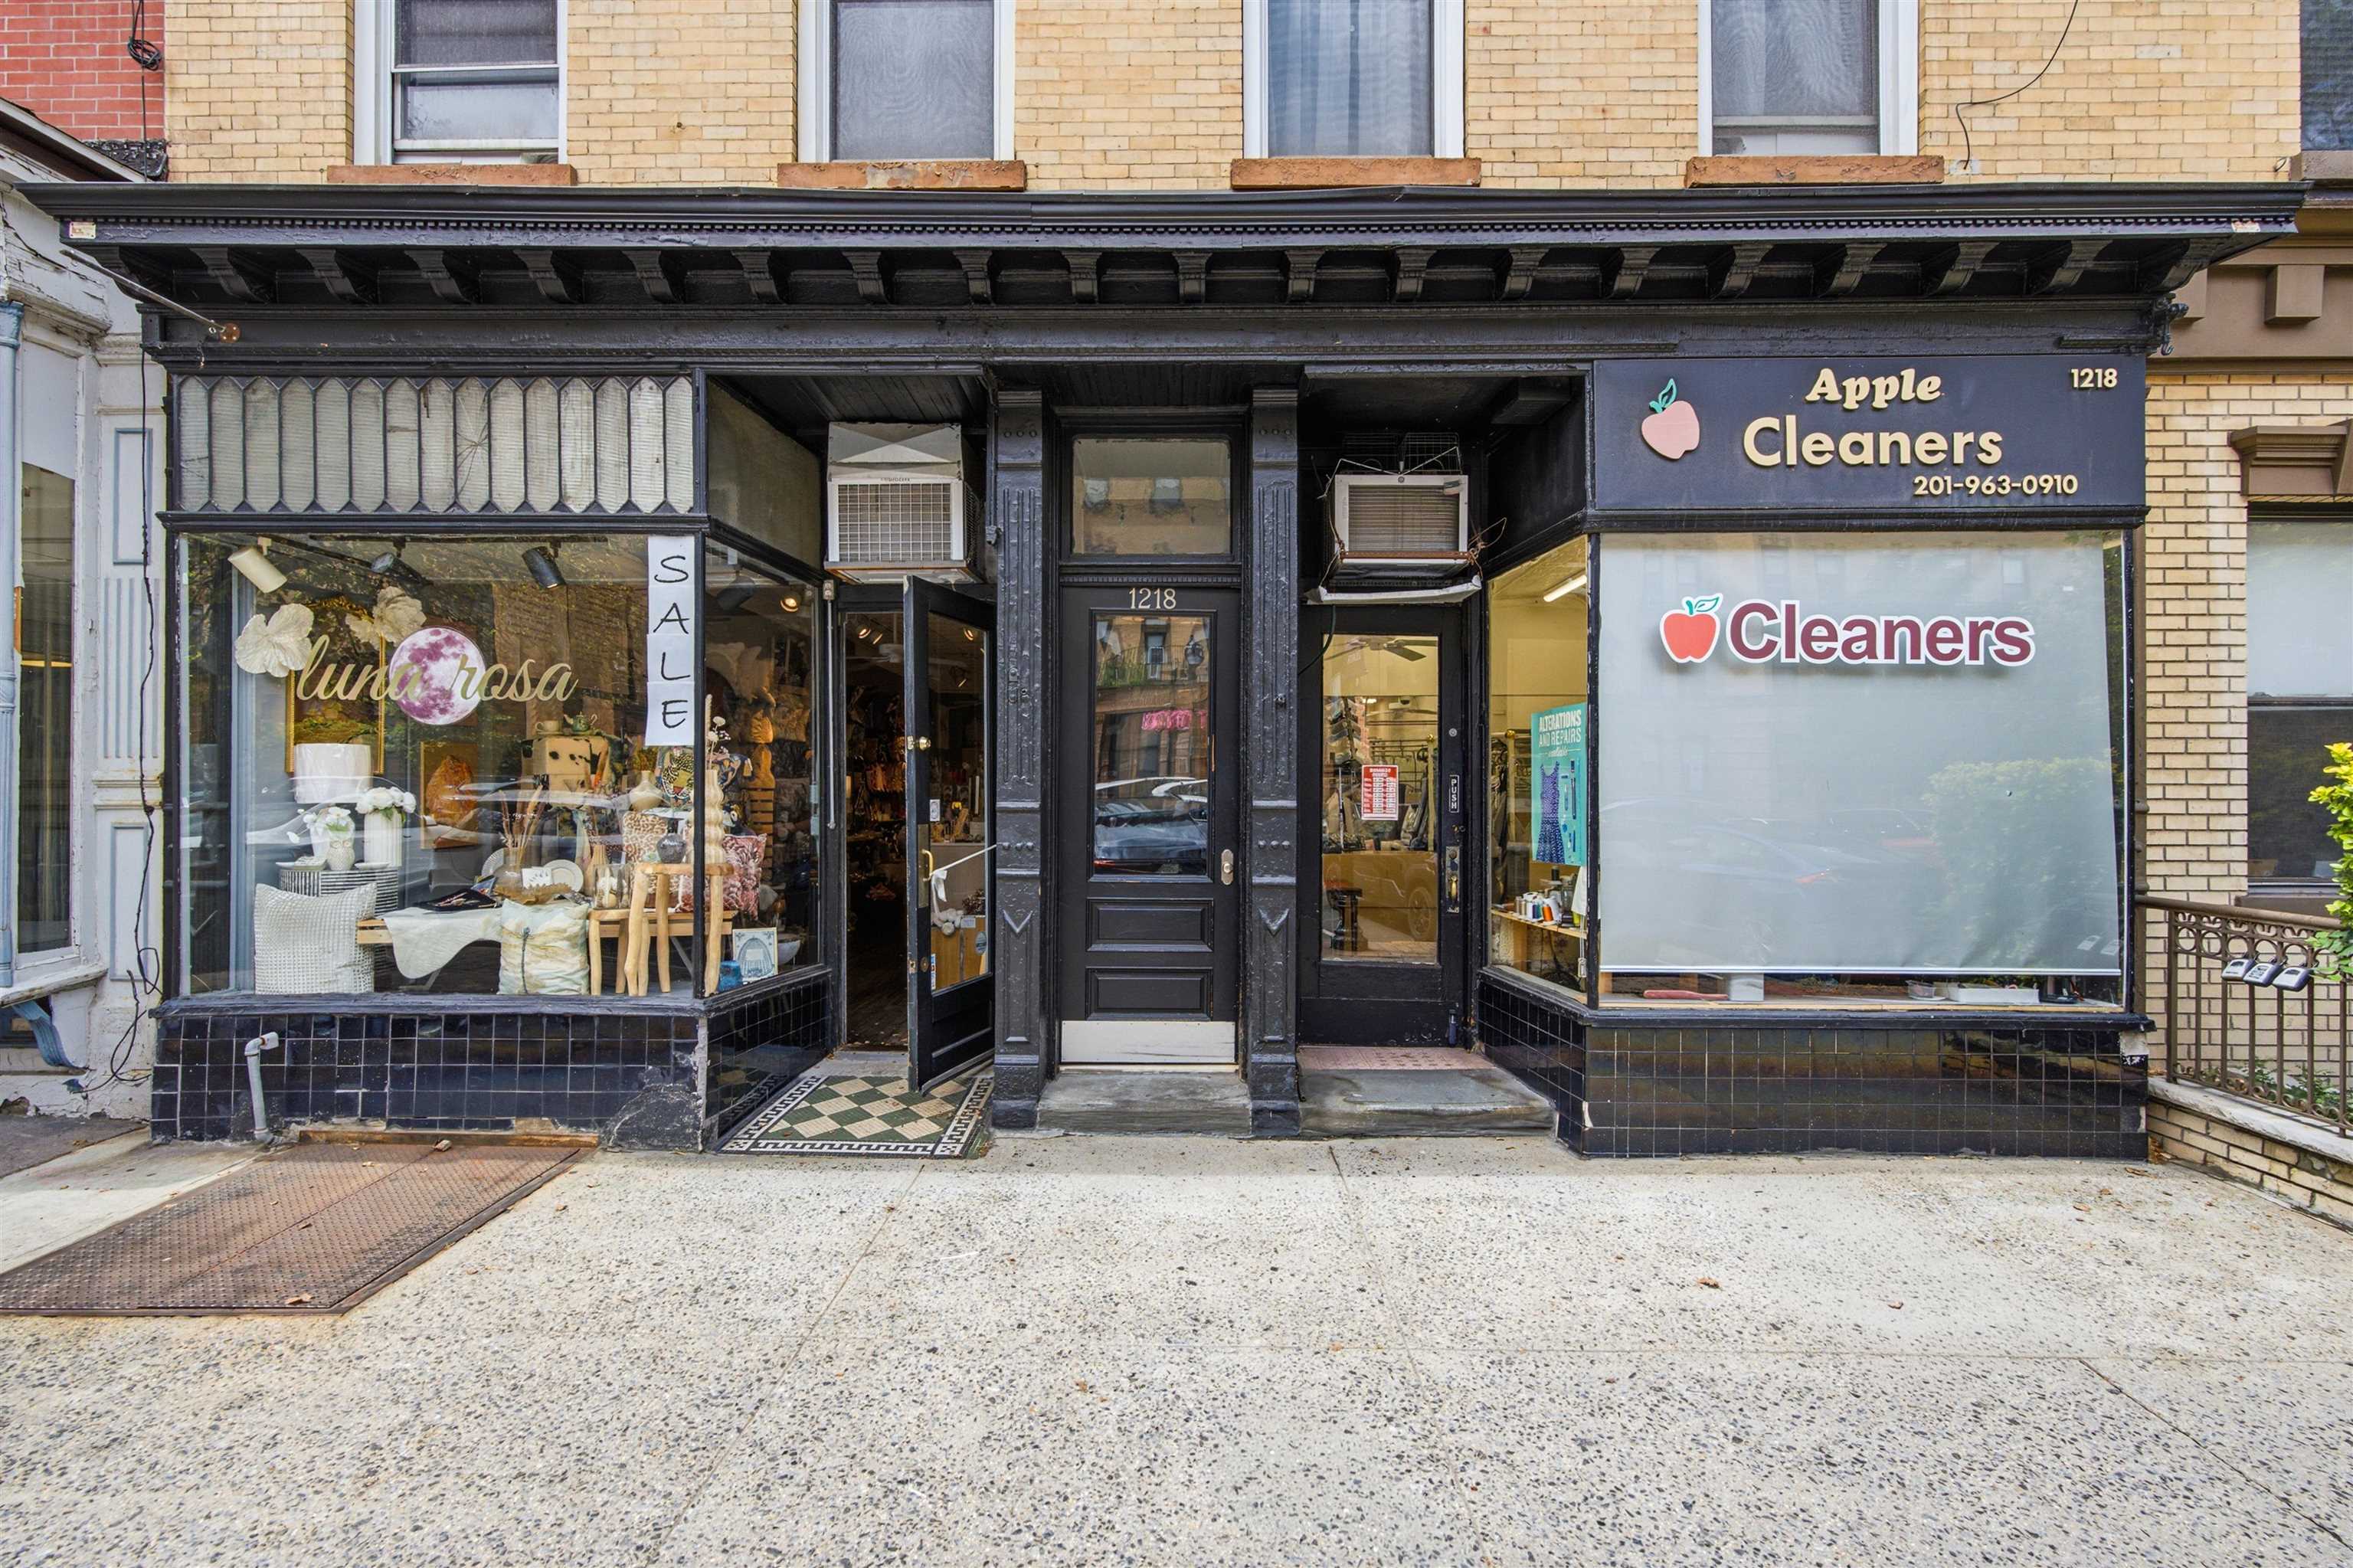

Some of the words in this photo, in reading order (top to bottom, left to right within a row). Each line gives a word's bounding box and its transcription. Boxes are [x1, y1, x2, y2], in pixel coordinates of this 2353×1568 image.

[1805, 367, 1942, 411] Apple
[2071, 368, 2118, 388] 1218
[1743, 414, 2004, 466] Cleaners
[1913, 475, 2079, 496] 201-963-0910
[1129, 588, 1176, 610] 1218
[653, 555, 691, 728] SALE
[1726, 600, 2036, 663] Cleaners
[296, 634, 422, 700] luna
[449, 654, 578, 702] rosa
[1539, 709, 1582, 732] ALTERATIONS
[1551, 727, 1582, 745] REPAIRS
